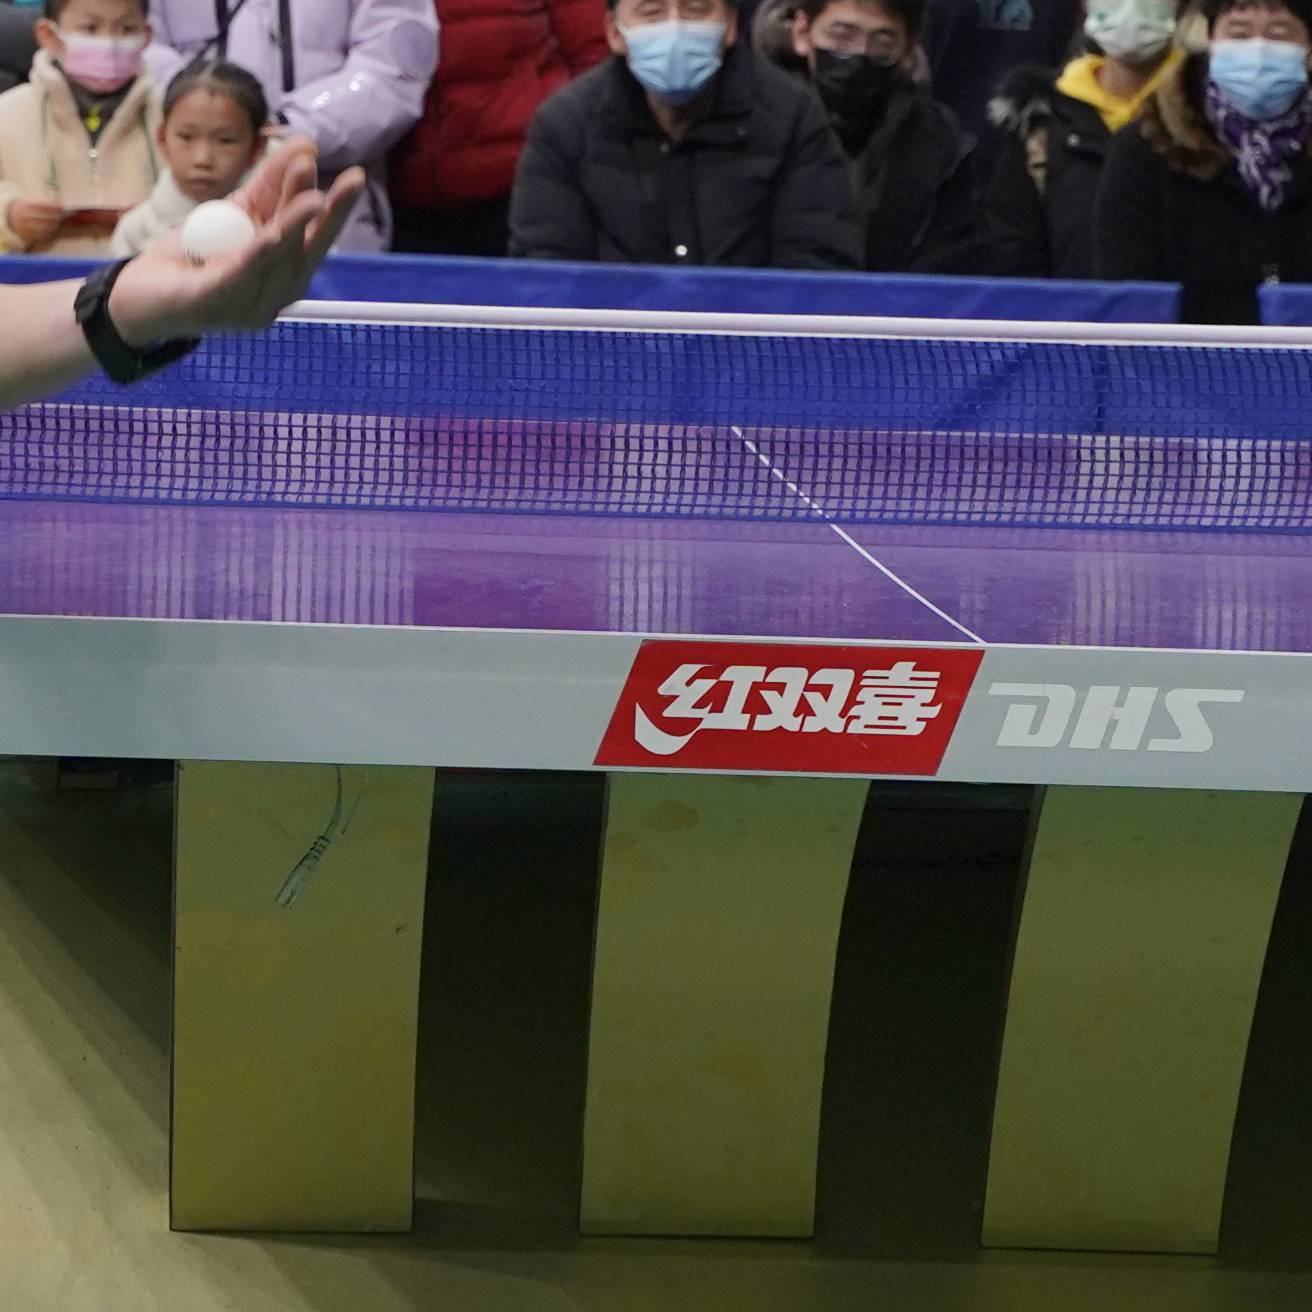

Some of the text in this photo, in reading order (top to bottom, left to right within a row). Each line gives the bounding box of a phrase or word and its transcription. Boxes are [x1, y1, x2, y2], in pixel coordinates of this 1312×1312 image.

[634, 661, 944, 756] 红双喜
[988, 683, 1245, 753] DHS
